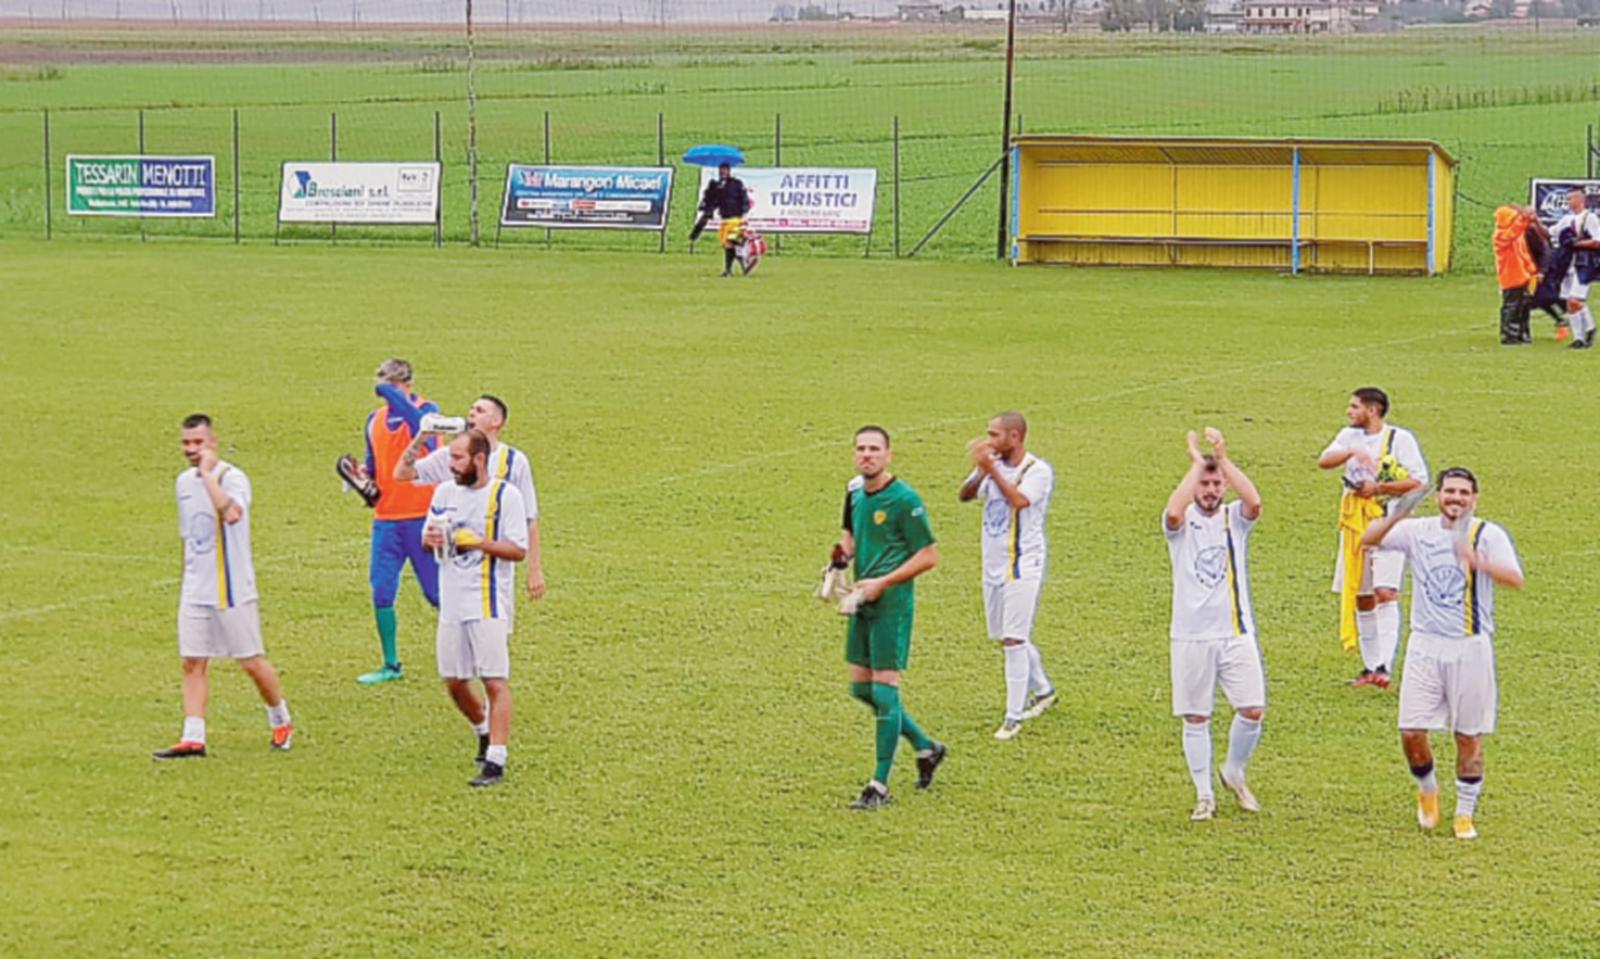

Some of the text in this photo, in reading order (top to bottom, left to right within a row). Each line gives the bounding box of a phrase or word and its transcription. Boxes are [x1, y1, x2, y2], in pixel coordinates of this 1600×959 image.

[75, 162, 206, 186] TESSARIN MENOTTI
[544, 172, 612, 192] Marangon
[780, 174, 849, 189] AFFITTI
[771, 191, 857, 208] TURISTICI
